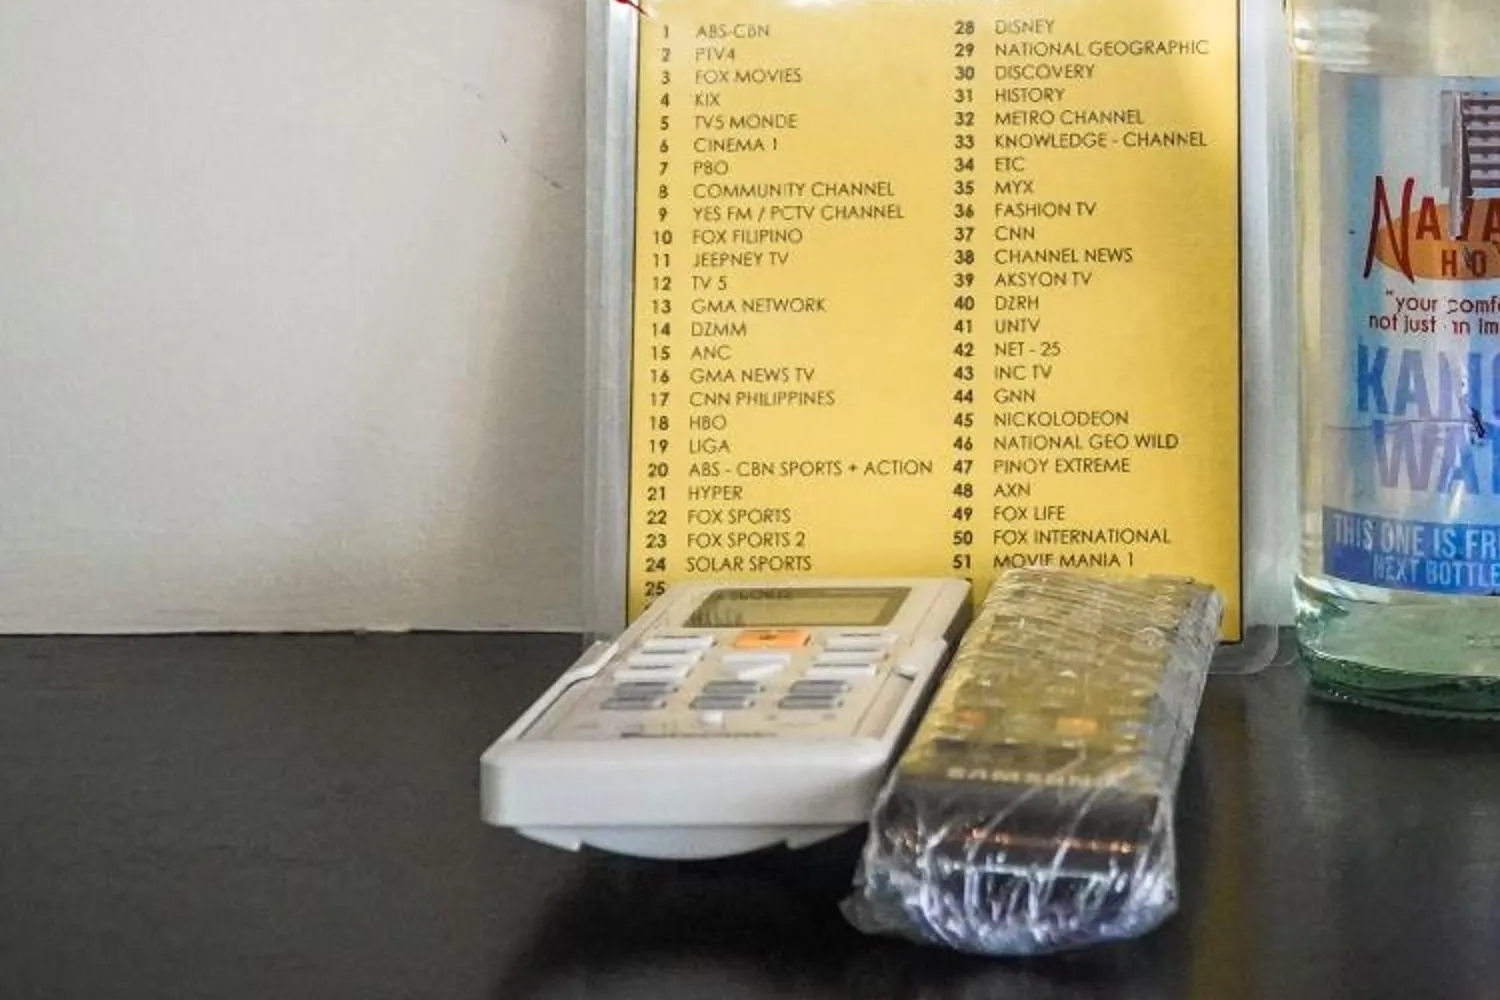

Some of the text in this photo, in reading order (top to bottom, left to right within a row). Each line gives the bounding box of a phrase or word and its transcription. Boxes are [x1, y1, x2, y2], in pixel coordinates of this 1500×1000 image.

[662, 24, 770, 38] 1 ABS-CBN
[954, 20, 1054, 34] 28 DISNEY
[662, 48, 670, 62] 2
[954, 40, 1209, 57] 29 NATIONAL GEOGRAPHIC
[662, 68, 802, 84] 3 FOX MOVIES
[954, 64, 1094, 80] 30 DISCOVERY
[660, 92, 720, 107] 4 KIX
[954, 88, 1065, 102] 31 HISTORY
[660, 114, 797, 130] 5 TV5 MONDE
[954, 110, 1144, 126] 32 METRO CHANNEL
[659, 138, 778, 153] 6 CINEMA 1
[954, 134, 974, 148] 33
[995, 134, 1108, 148] KNOWLEDGE
[1123, 132, 1207, 147] CHANNEL
[659, 161, 728, 176] 7 PBO
[954, 157, 1024, 172] 34 ETC
[659, 182, 894, 199] 8 COMMUNITY CHANNEL
[954, 180, 1034, 194] 35 MYX
[658, 204, 904, 223] 9 YES FM / PCTV CHANNEL
[954, 202, 1096, 218] 36 FASHION TV
[654, 228, 803, 244] 10 FOX FILIPINO
[954, 226, 1034, 240] 37 CNN
[653, 252, 790, 268] 11 JEEPNEY TV
[954, 248, 1132, 264] 38 CHANNEL NEWS
[652, 276, 727, 290] 12 TV 5
[954, 272, 1092, 287] 39 AKSYON TV
[652, 298, 826, 314] 13 GMA NETWORK
[954, 296, 1038, 310] 40 DZRH
[651, 322, 747, 337] 14 DZMM
[954, 318, 1040, 333] 41 UNTV
[1369, 314, 1397, 331] not
[1403, 315, 1436, 333] just
[1452, 319, 1471, 335] in
[650, 346, 732, 360] 15 ANC
[953, 343, 974, 357] 42
[994, 343, 1025, 356] NET
[1041, 342, 1061, 356] 25
[650, 367, 815, 384] 16 GMA NEWS TV
[953, 365, 1052, 380] 43 INC TV
[650, 391, 836, 407] 17 CNN PHILIPPINES
[953, 389, 1035, 403] 44 GNN
[650, 415, 727, 431] 18 HBO
[954, 411, 1128, 427] 45 NICKOLODEON
[649, 439, 730, 454] 19 LIGA
[953, 433, 1178, 450] 46 NATIONAL GEO WILD
[648, 463, 668, 478] 20
[688, 462, 721, 477] ABS
[737, 461, 775, 477] CBN
[780, 461, 842, 476] SPORTS
[863, 460, 933, 475] ACTION
[953, 458, 1130, 474] 47 PINOY EXTREME
[647, 486, 743, 500] 21 HYPER
[952, 483, 1031, 498] 48 AXN
[647, 508, 791, 525] 22 FOX SPORTS
[952, 506, 1066, 521] 49 FOX LIFE
[646, 532, 806, 549] 23 FOX SPORTS 2
[952, 528, 1171, 545] 50 FOX INTERNATIONAL
[1333, 516, 1373, 554] THIS
[1380, 524, 1425, 557] ONE
[1432, 527, 1458, 560] IS
[645, 556, 812, 572] 24 SOLAR SPORTS
[952, 555, 971, 568] 51
[1060, 552, 1120, 567] MANIA
[1128, 551, 1133, 567] 1
[1372, 555, 1419, 583] NEXT
[1425, 558, 1500, 588] BOTTLE
[645, 581, 665, 596] 25
